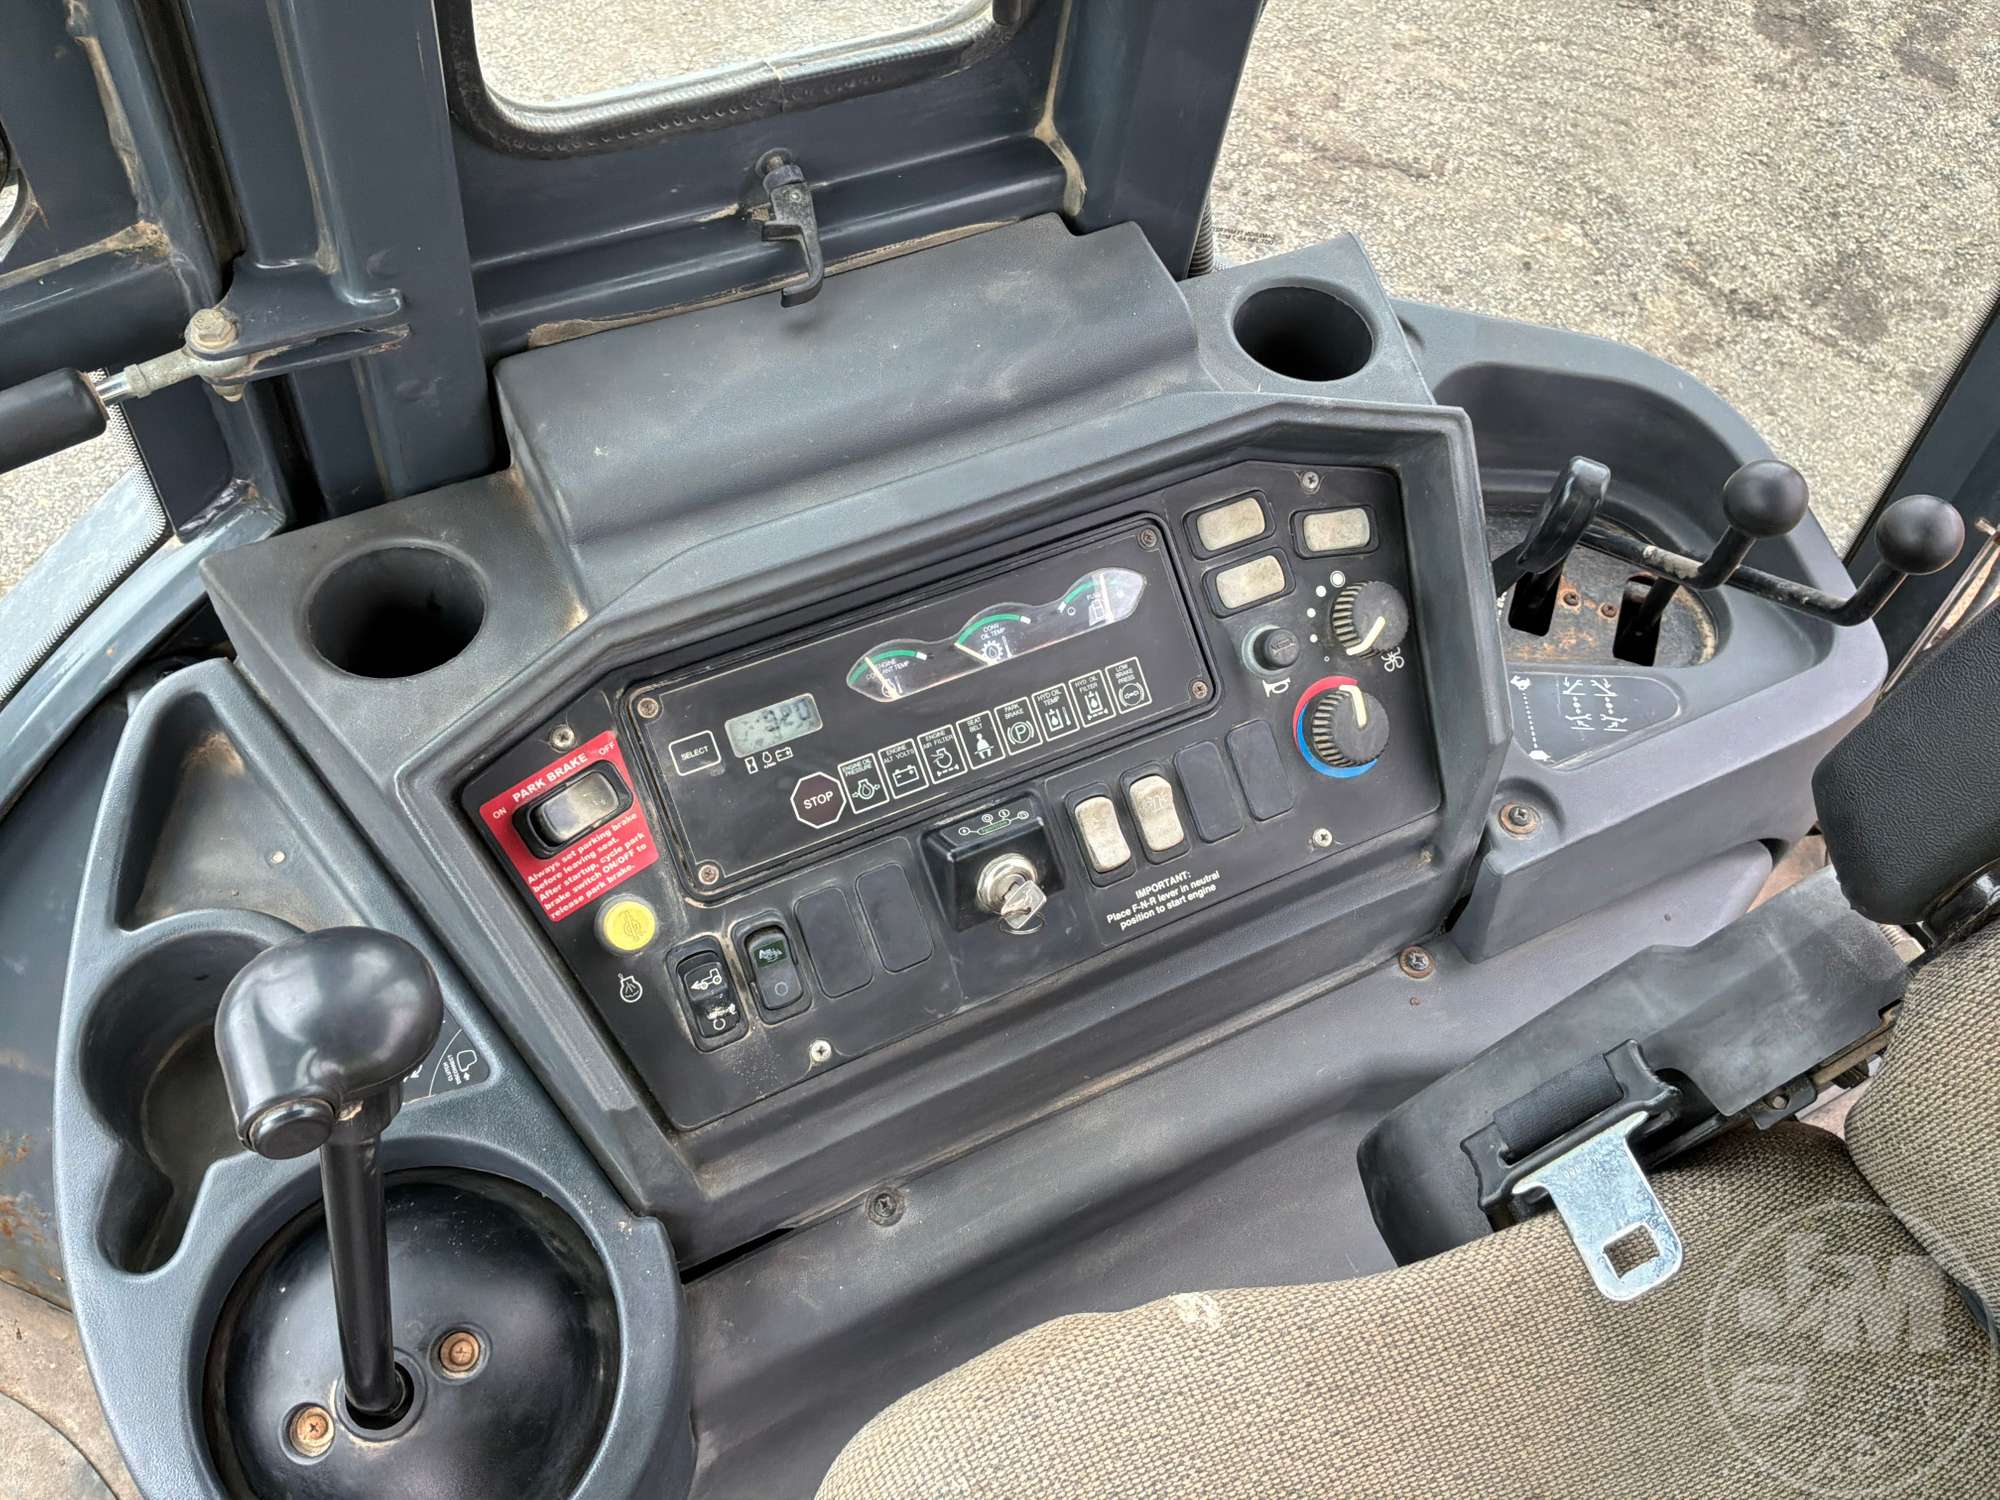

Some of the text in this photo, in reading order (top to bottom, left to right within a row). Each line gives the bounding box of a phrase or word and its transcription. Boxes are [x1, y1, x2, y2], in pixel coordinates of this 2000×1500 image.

[1115, 663, 1129, 672] LOW
[1115, 668, 1134, 679] BRAKE
[1088, 675, 1098, 683] OIL
[1117, 674, 1136, 685] PRESS
[1050, 688, 1062, 697] OIL
[1079, 682, 1098, 693] FILTER
[1043, 695, 1060, 706] TEMP
[1004, 703, 1020, 713] PARK
[1004, 708, 1024, 720] BRAKE
[967, 716, 981, 727] SEAT
[968, 723, 983, 733] BELT
[922, 734, 954, 750] AIR FILTER
[925, 730, 946, 741] ENGINE
[598, 741, 616, 756] OFF
[681, 745, 710, 761] SELECT
[885, 744, 907, 756] ENGINE
[883, 748, 915, 764] ALT VOLTS
[512, 752, 589, 803] PARK BRAKE
[803, 790, 835, 810] STOP
[492, 807, 507, 820] ON
[528, 813, 637, 884] Always set parking brake
[532, 837, 620, 893] before leaving seat.
[540, 832, 645, 902] After startup, cycle park
[544, 843, 647, 910] brake switch ON/OFF to
[551, 864, 635, 919] release park brake.
[1135, 870, 1192, 899] IMPORTANT:
[1106, 870, 1221, 923] Place F-N-R lever in neutral
[1120, 884, 1217, 931] position to start engine
